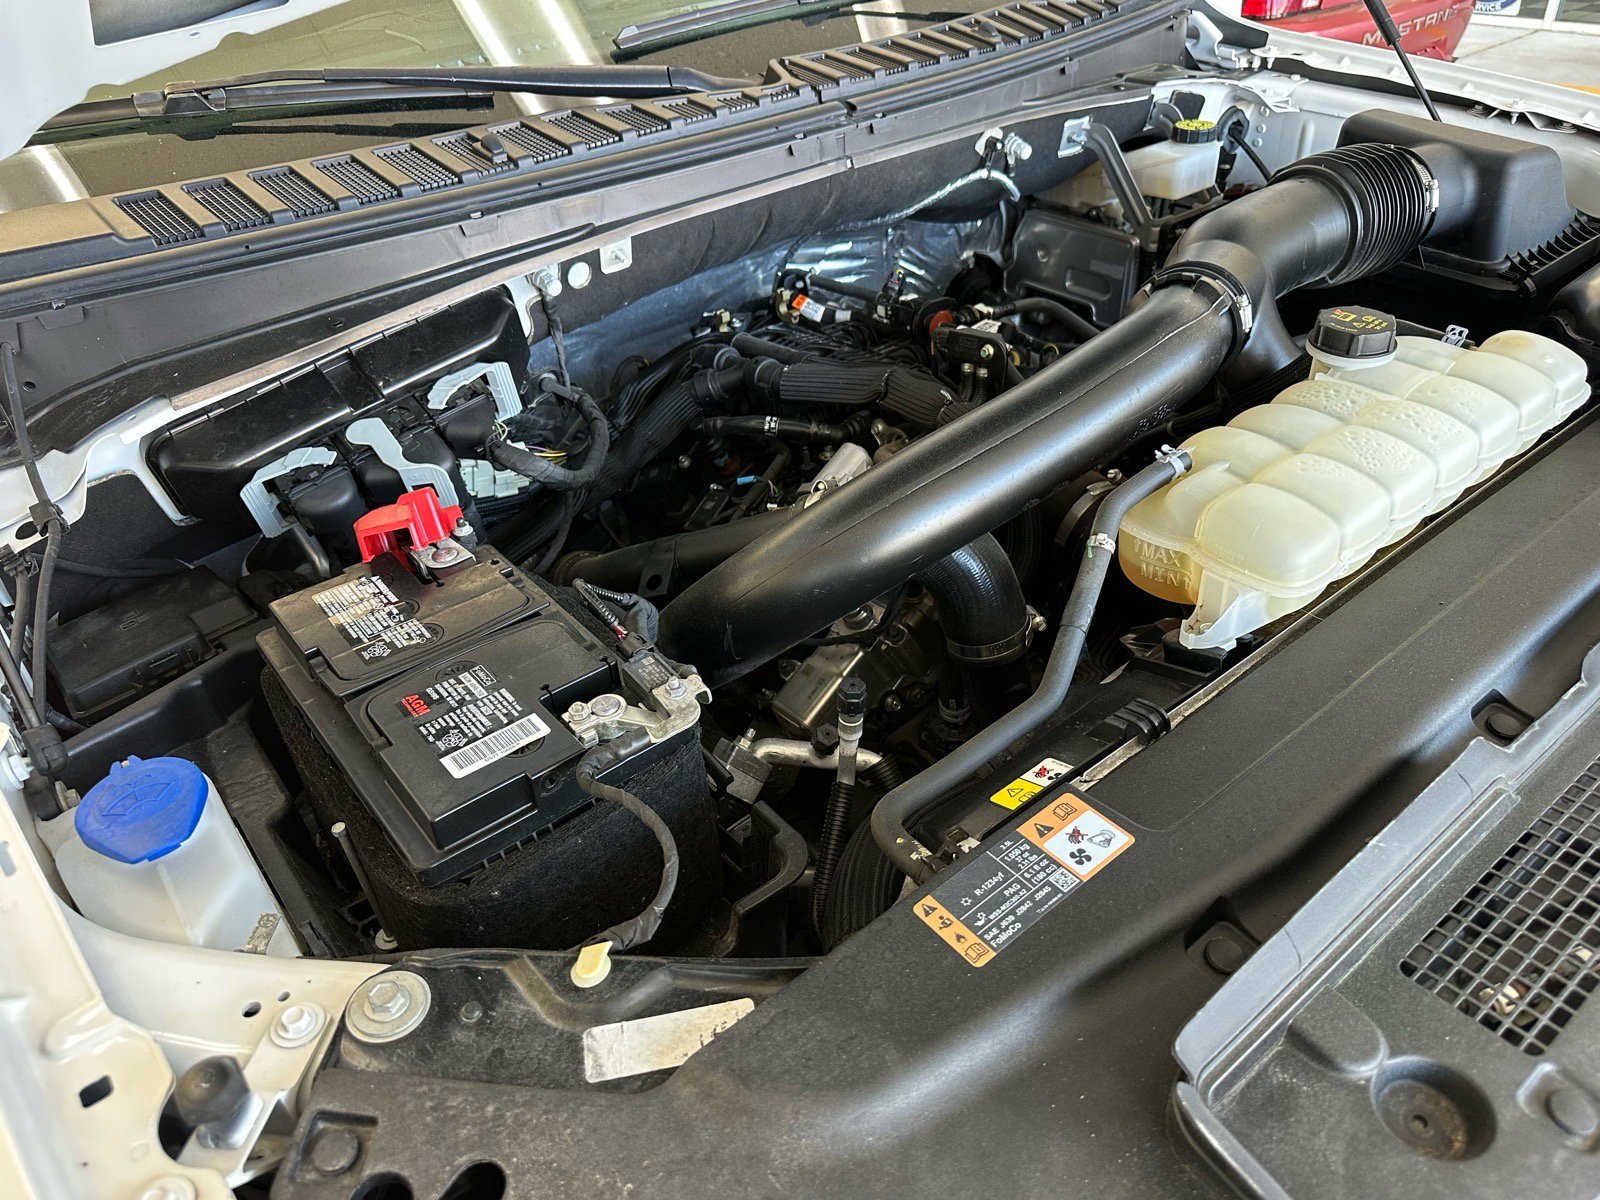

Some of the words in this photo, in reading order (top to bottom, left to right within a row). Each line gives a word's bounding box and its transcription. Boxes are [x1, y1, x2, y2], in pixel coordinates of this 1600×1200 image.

[1362, 3, 1460, 45] MSTANG
[1142, 542, 1180, 567] MAX
[1141, 562, 1180, 587] MIN
[405, 694, 431, 716] AGM
[1000, 840, 1013, 850] 3.5L
[1020, 844, 1030, 854] kg
[1018, 859, 1029, 870] 2.31
[1027, 854, 1038, 863] lbs
[1024, 868, 1034, 878] 6.1
[1039, 859, 1049, 868] oz
[974, 871, 1005, 896] R-1234yf
[1031, 870, 1047, 885] (180
[1045, 863, 1058, 875] cc)
[1003, 883, 1021, 896] PAG
[984, 926, 999, 940] SAE
[1000, 915, 1015, 929] J639
[1016, 901, 1033, 916] J2842
[1034, 886, 1052, 901] J2845
[990, 922, 1022, 948] FoMoCo
